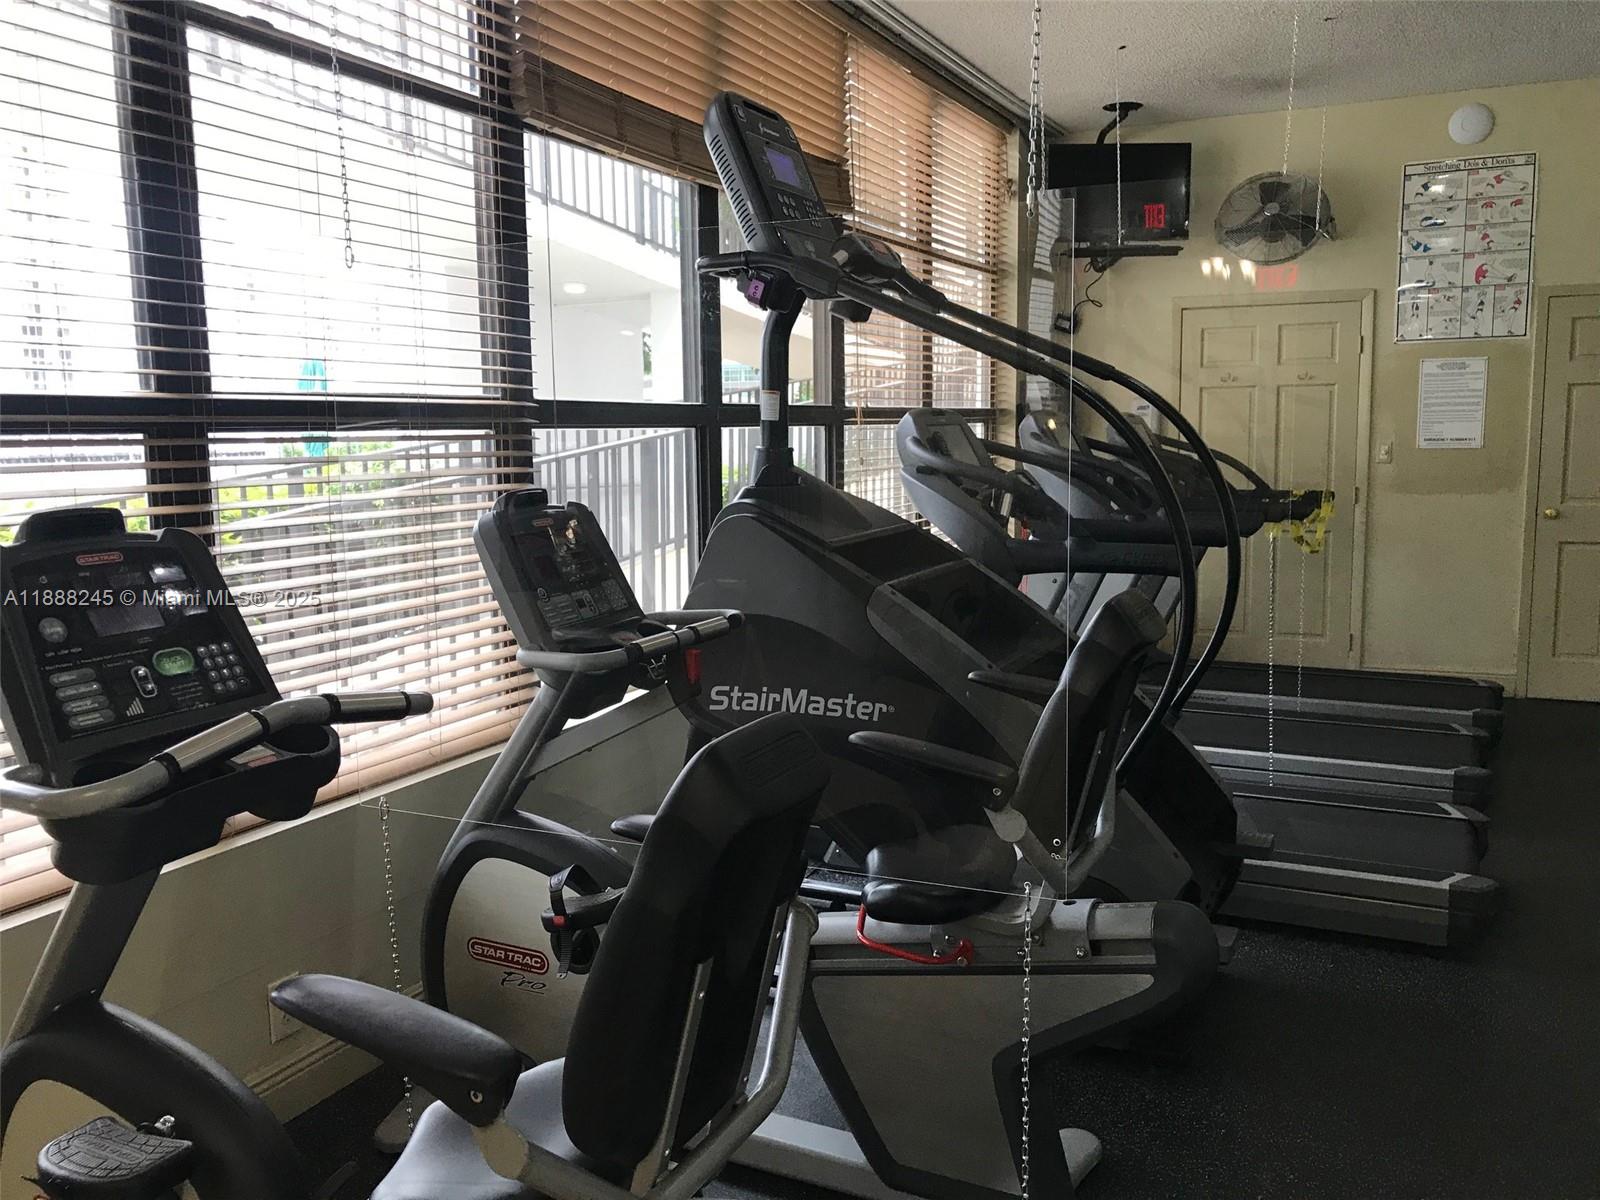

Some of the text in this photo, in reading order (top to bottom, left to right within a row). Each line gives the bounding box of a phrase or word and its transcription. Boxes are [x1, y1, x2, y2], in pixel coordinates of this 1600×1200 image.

[1423, 161, 1460, 172] Stretching
[472, 943, 543, 967] STAR TRAC
[500, 971, 547, 991] Pro
